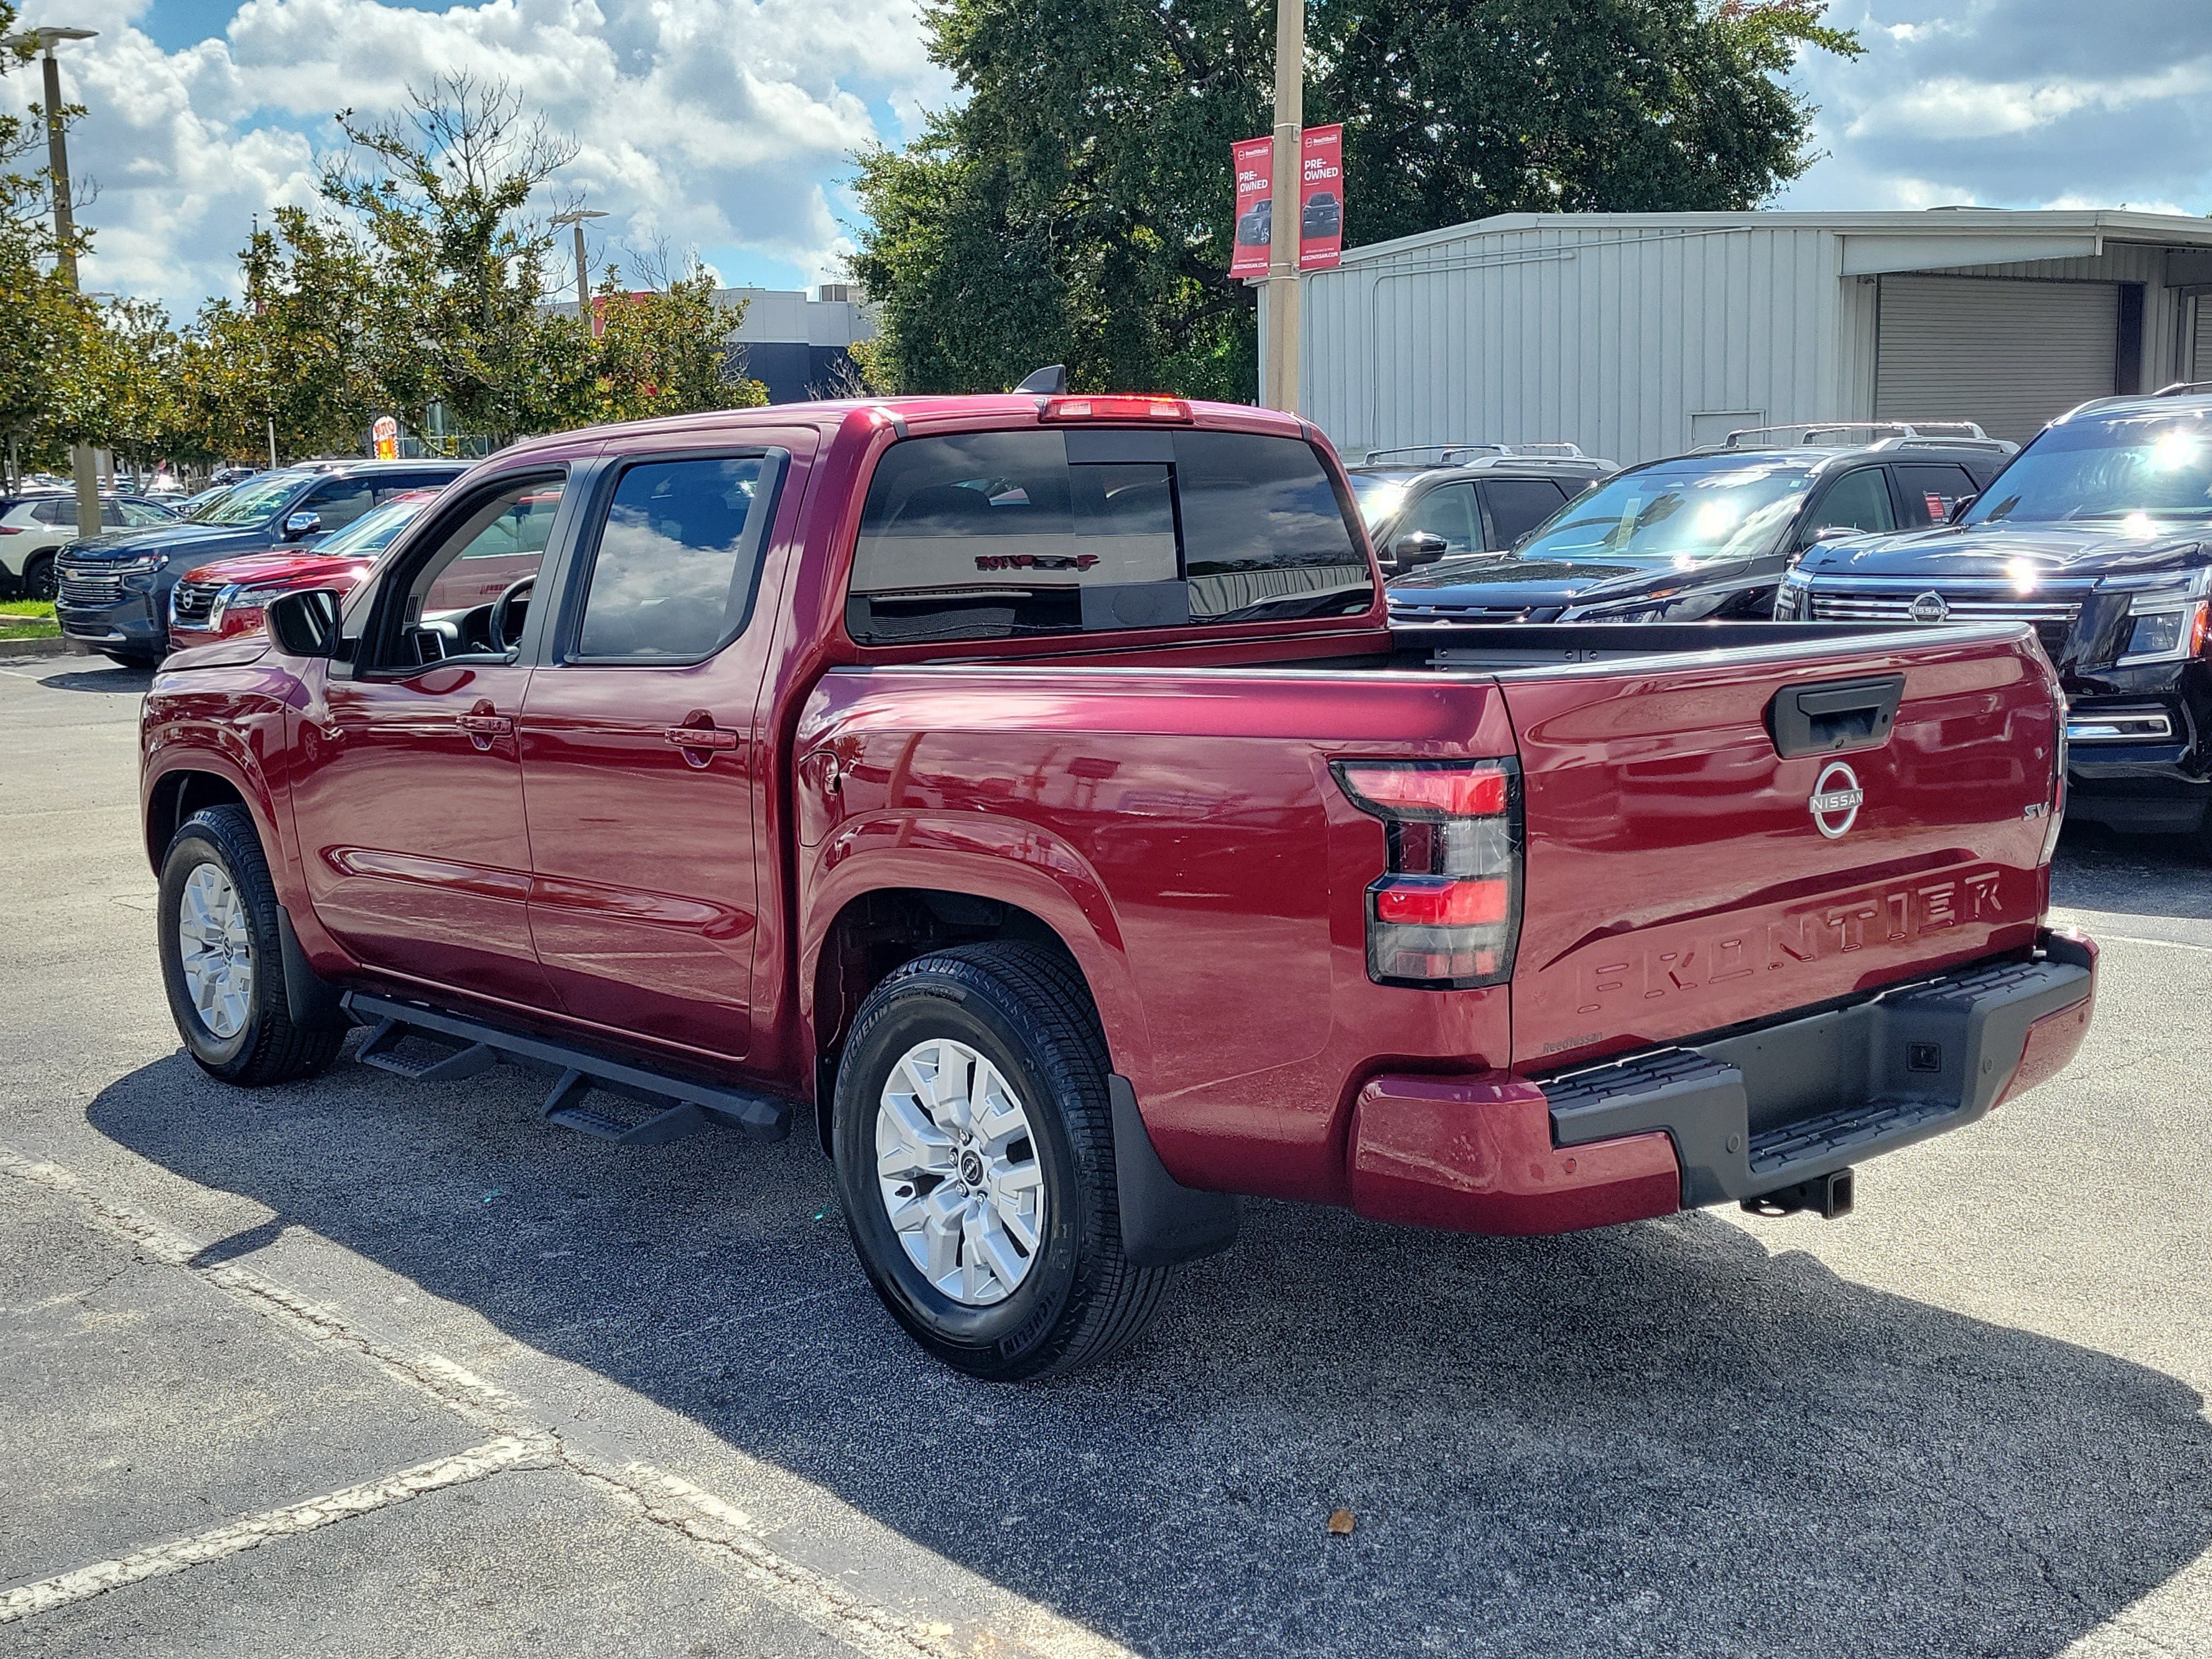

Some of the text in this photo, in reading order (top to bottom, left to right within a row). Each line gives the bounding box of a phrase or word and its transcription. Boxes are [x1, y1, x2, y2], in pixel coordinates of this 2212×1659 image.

[1305, 158, 1327, 170] PRE-
[1239, 171, 1257, 182] PRE-
[1304, 167, 1339, 181] OWNED
[1240, 179, 1268, 193] OWNED
[1813, 792, 1863, 810] NISSAN
[2023, 802, 2050, 821] SV
[1577, 871, 2004, 1014] FRONTIER
